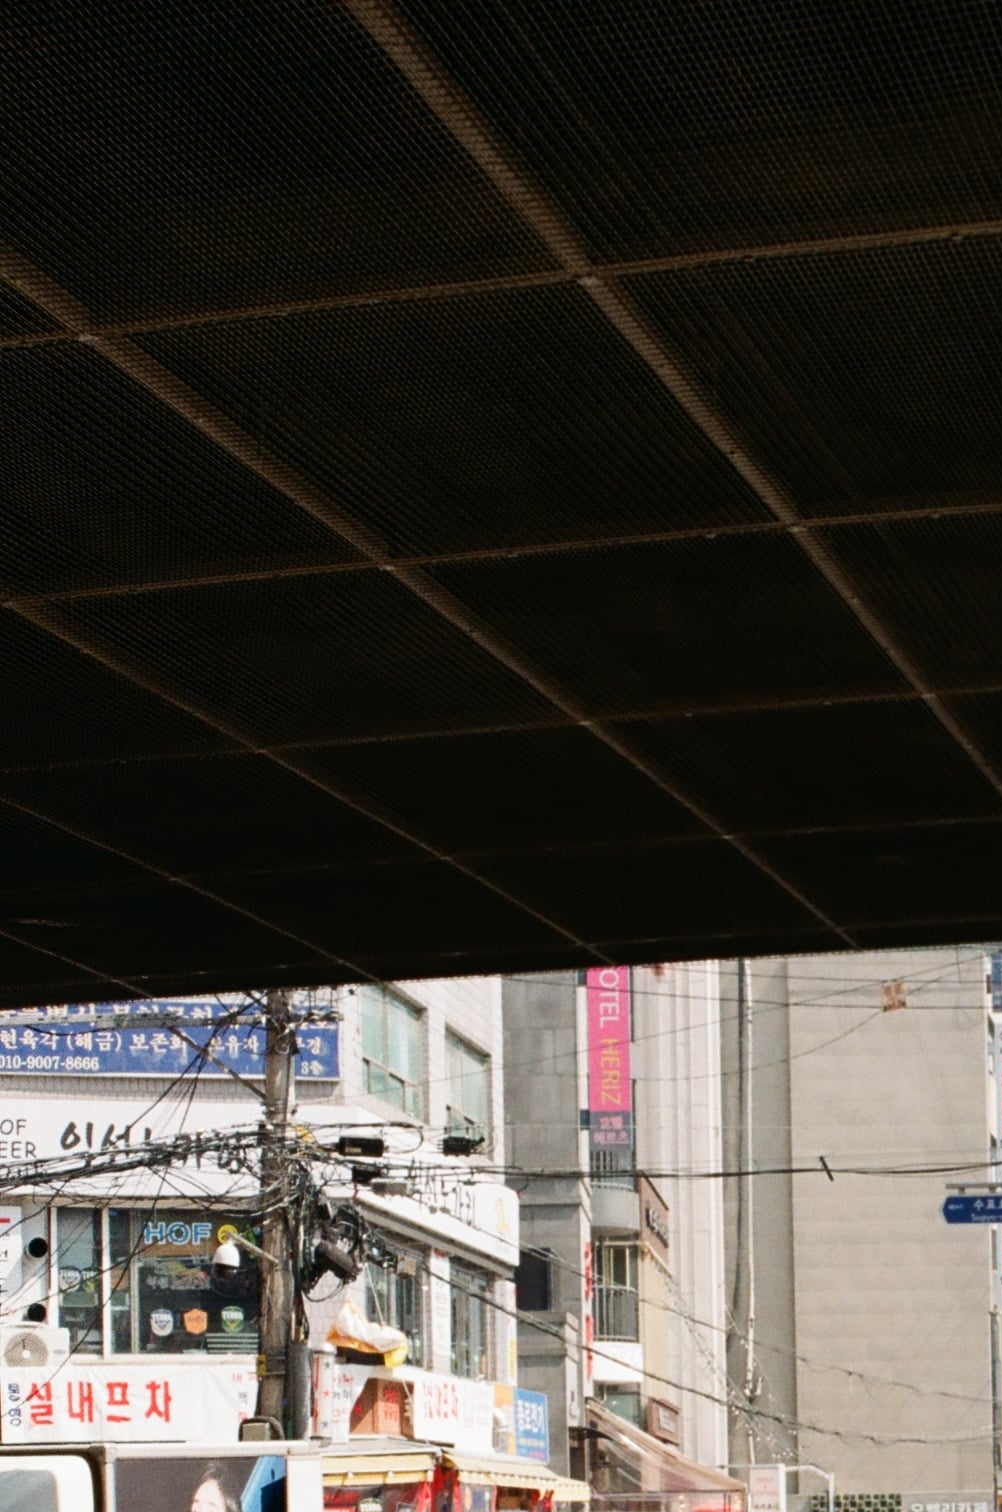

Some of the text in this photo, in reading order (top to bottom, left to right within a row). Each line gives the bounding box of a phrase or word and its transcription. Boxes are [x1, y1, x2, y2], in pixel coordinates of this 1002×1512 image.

[66, 1031, 122, 1052] (해금)
[601, 1038, 622, 1106] HERIZ
[144, 1221, 212, 1245] HOF
